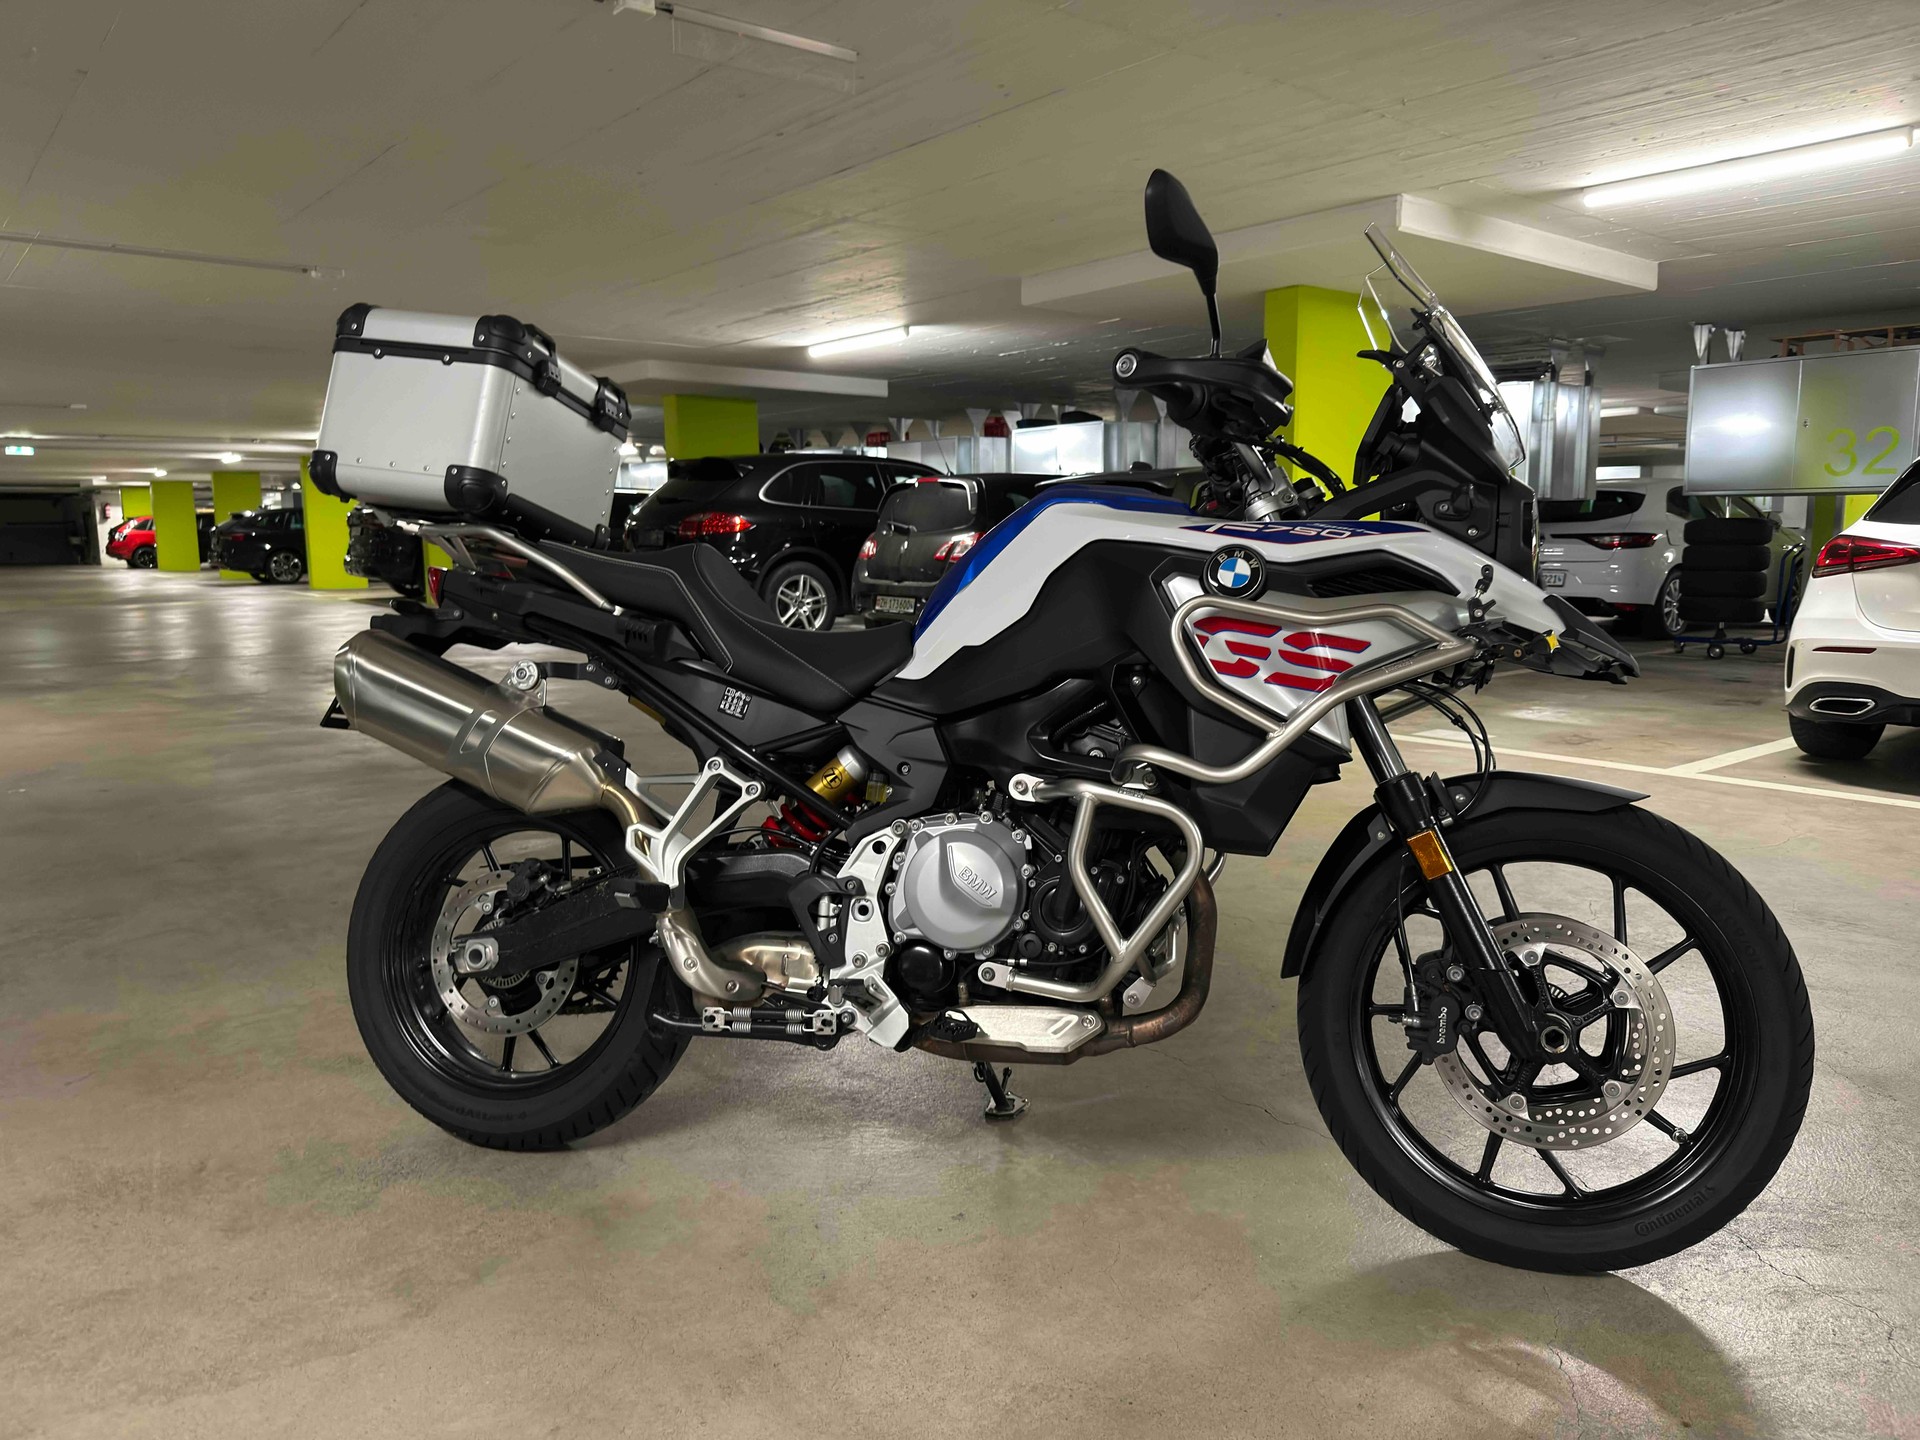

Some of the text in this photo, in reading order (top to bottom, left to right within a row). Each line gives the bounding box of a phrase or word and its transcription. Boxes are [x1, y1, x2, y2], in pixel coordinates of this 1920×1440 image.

[1823, 426, 1900, 477] 32
[1217, 550, 1260, 570] BMW
[1193, 616, 1372, 693] GS
[822, 767, 843, 790] ZF
[958, 865, 998, 901] BMW
[1436, 1006, 1448, 1044] brembo
